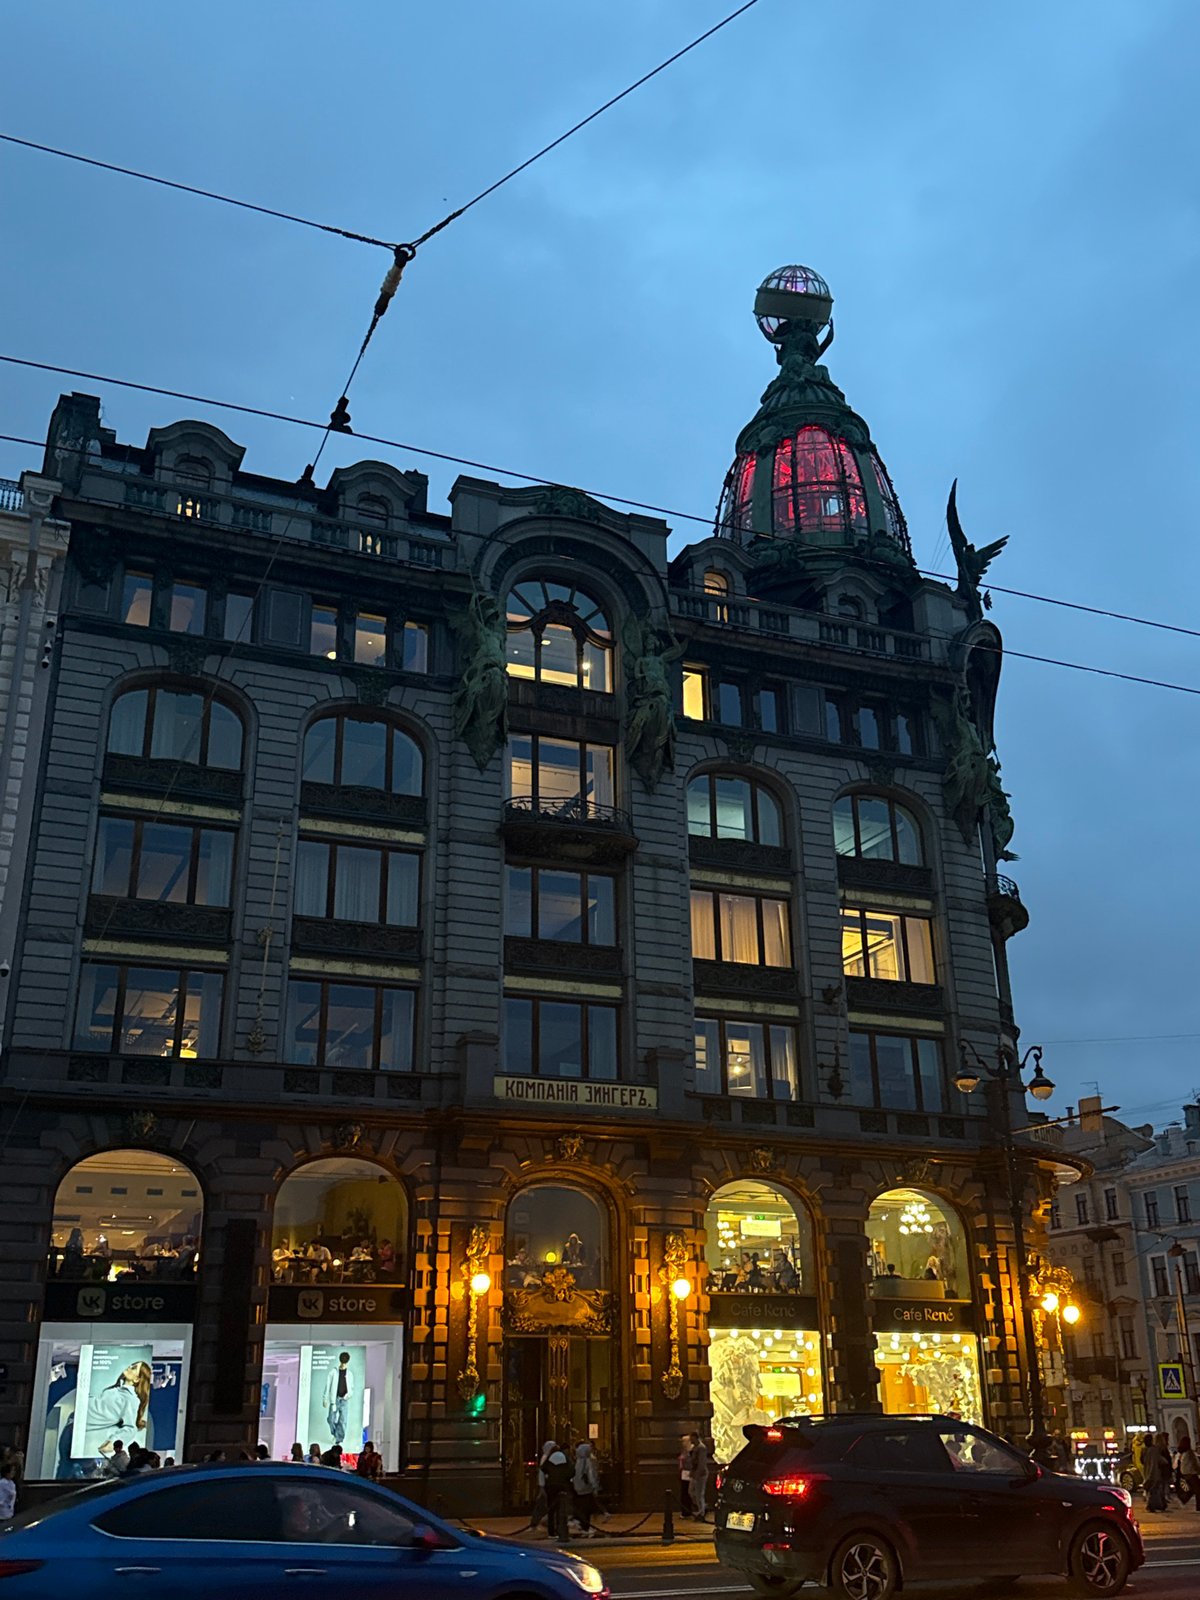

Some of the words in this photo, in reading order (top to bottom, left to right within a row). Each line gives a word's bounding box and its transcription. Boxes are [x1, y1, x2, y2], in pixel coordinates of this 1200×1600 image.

[112, 1294, 164, 1310] store
[328, 1295, 377, 1312] store
[730, 1302, 761, 1317] Cafe
[764, 1302, 796, 1318] René
[893, 1307, 922, 1321] Cafe
[924, 1306, 955, 1322] René
